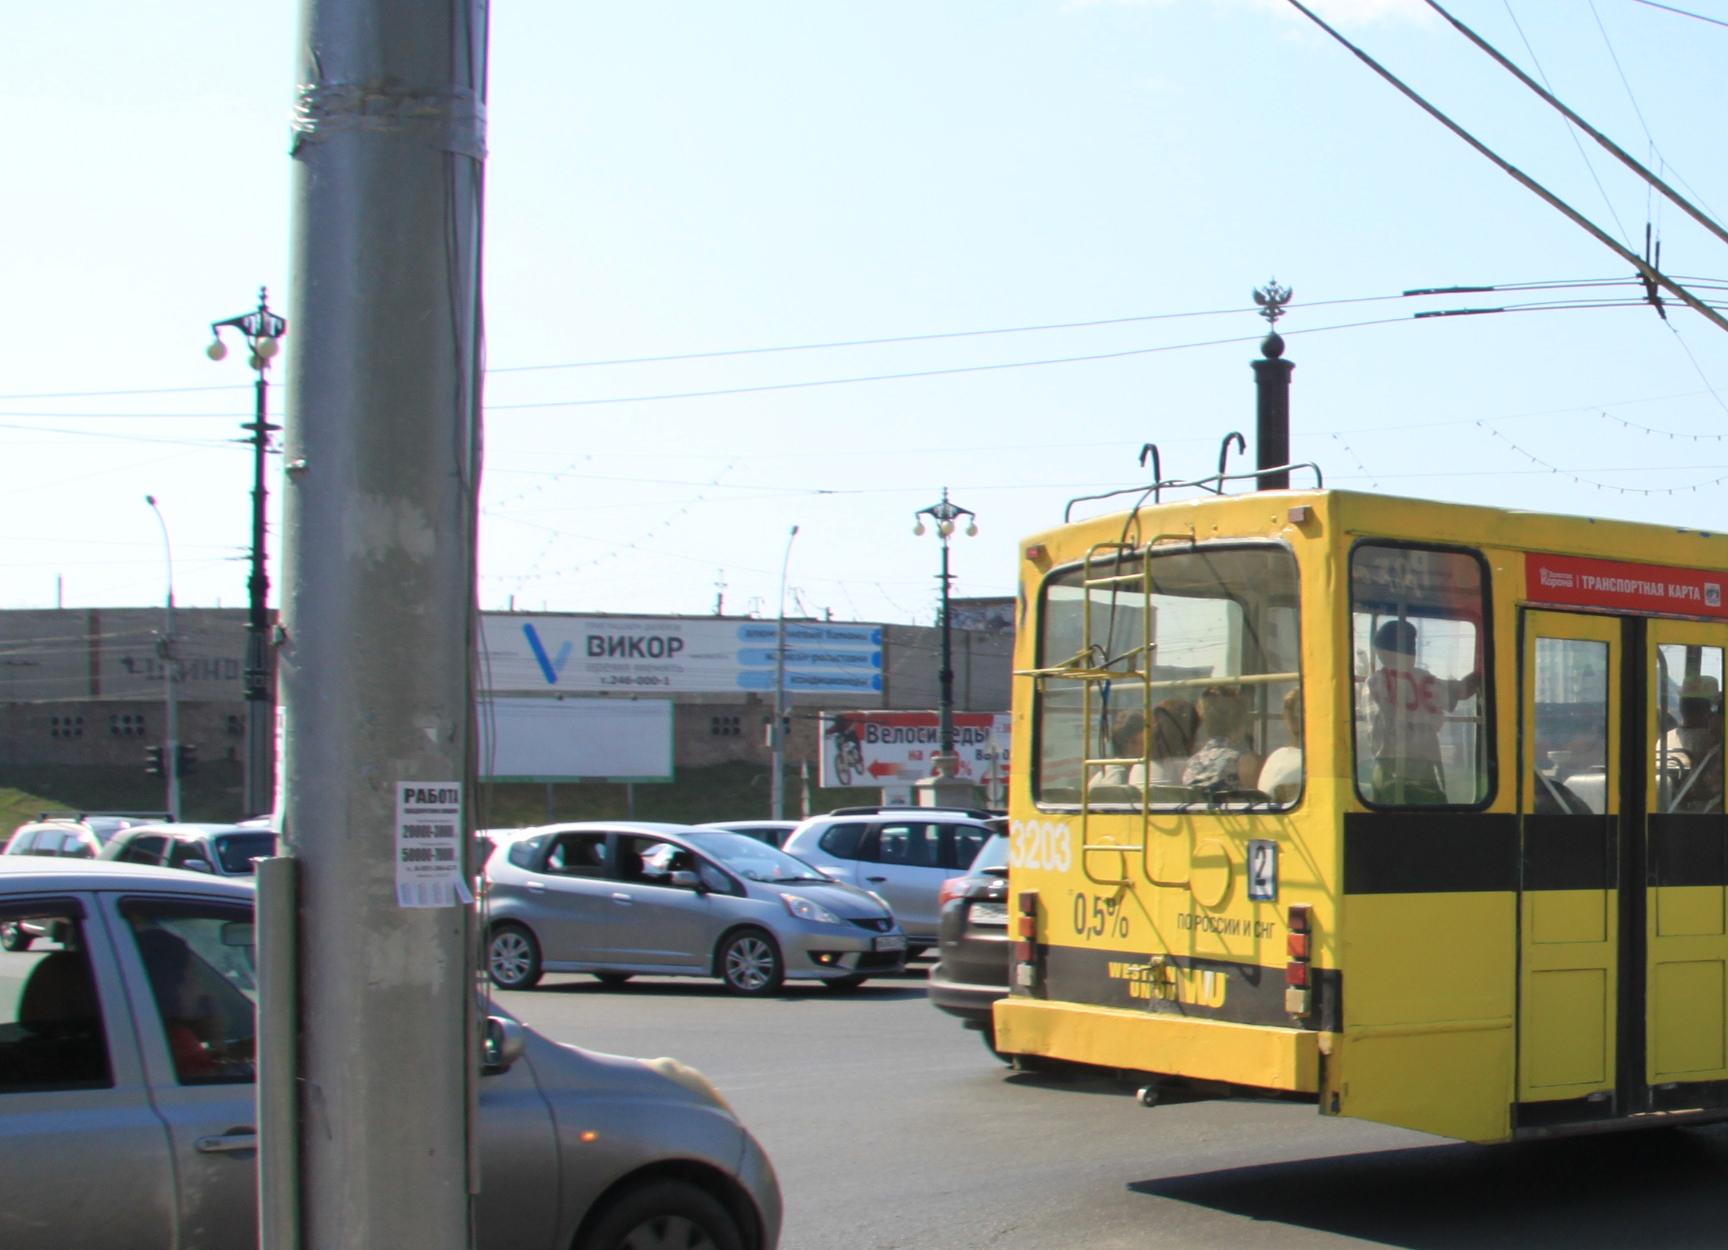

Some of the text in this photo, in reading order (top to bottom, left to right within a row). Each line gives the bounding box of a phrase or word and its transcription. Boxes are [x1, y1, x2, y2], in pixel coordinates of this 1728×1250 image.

[1582, 576, 1701, 600] ТРАНСПОРТНАЯ КАРТА
[586, 634, 685, 659] ВИКОР
[866, 724, 990, 746] Велосиеды
[1009, 820, 1072, 873] 3203
[1255, 845, 1267, 886] 2
[1074, 892, 1129, 941] 0,5%
[1178, 913, 1275, 939] ПО РОССИИ И СНГ
[1108, 962, 1176, 983] WESTN
[1130, 981, 1176, 1001] UNON
